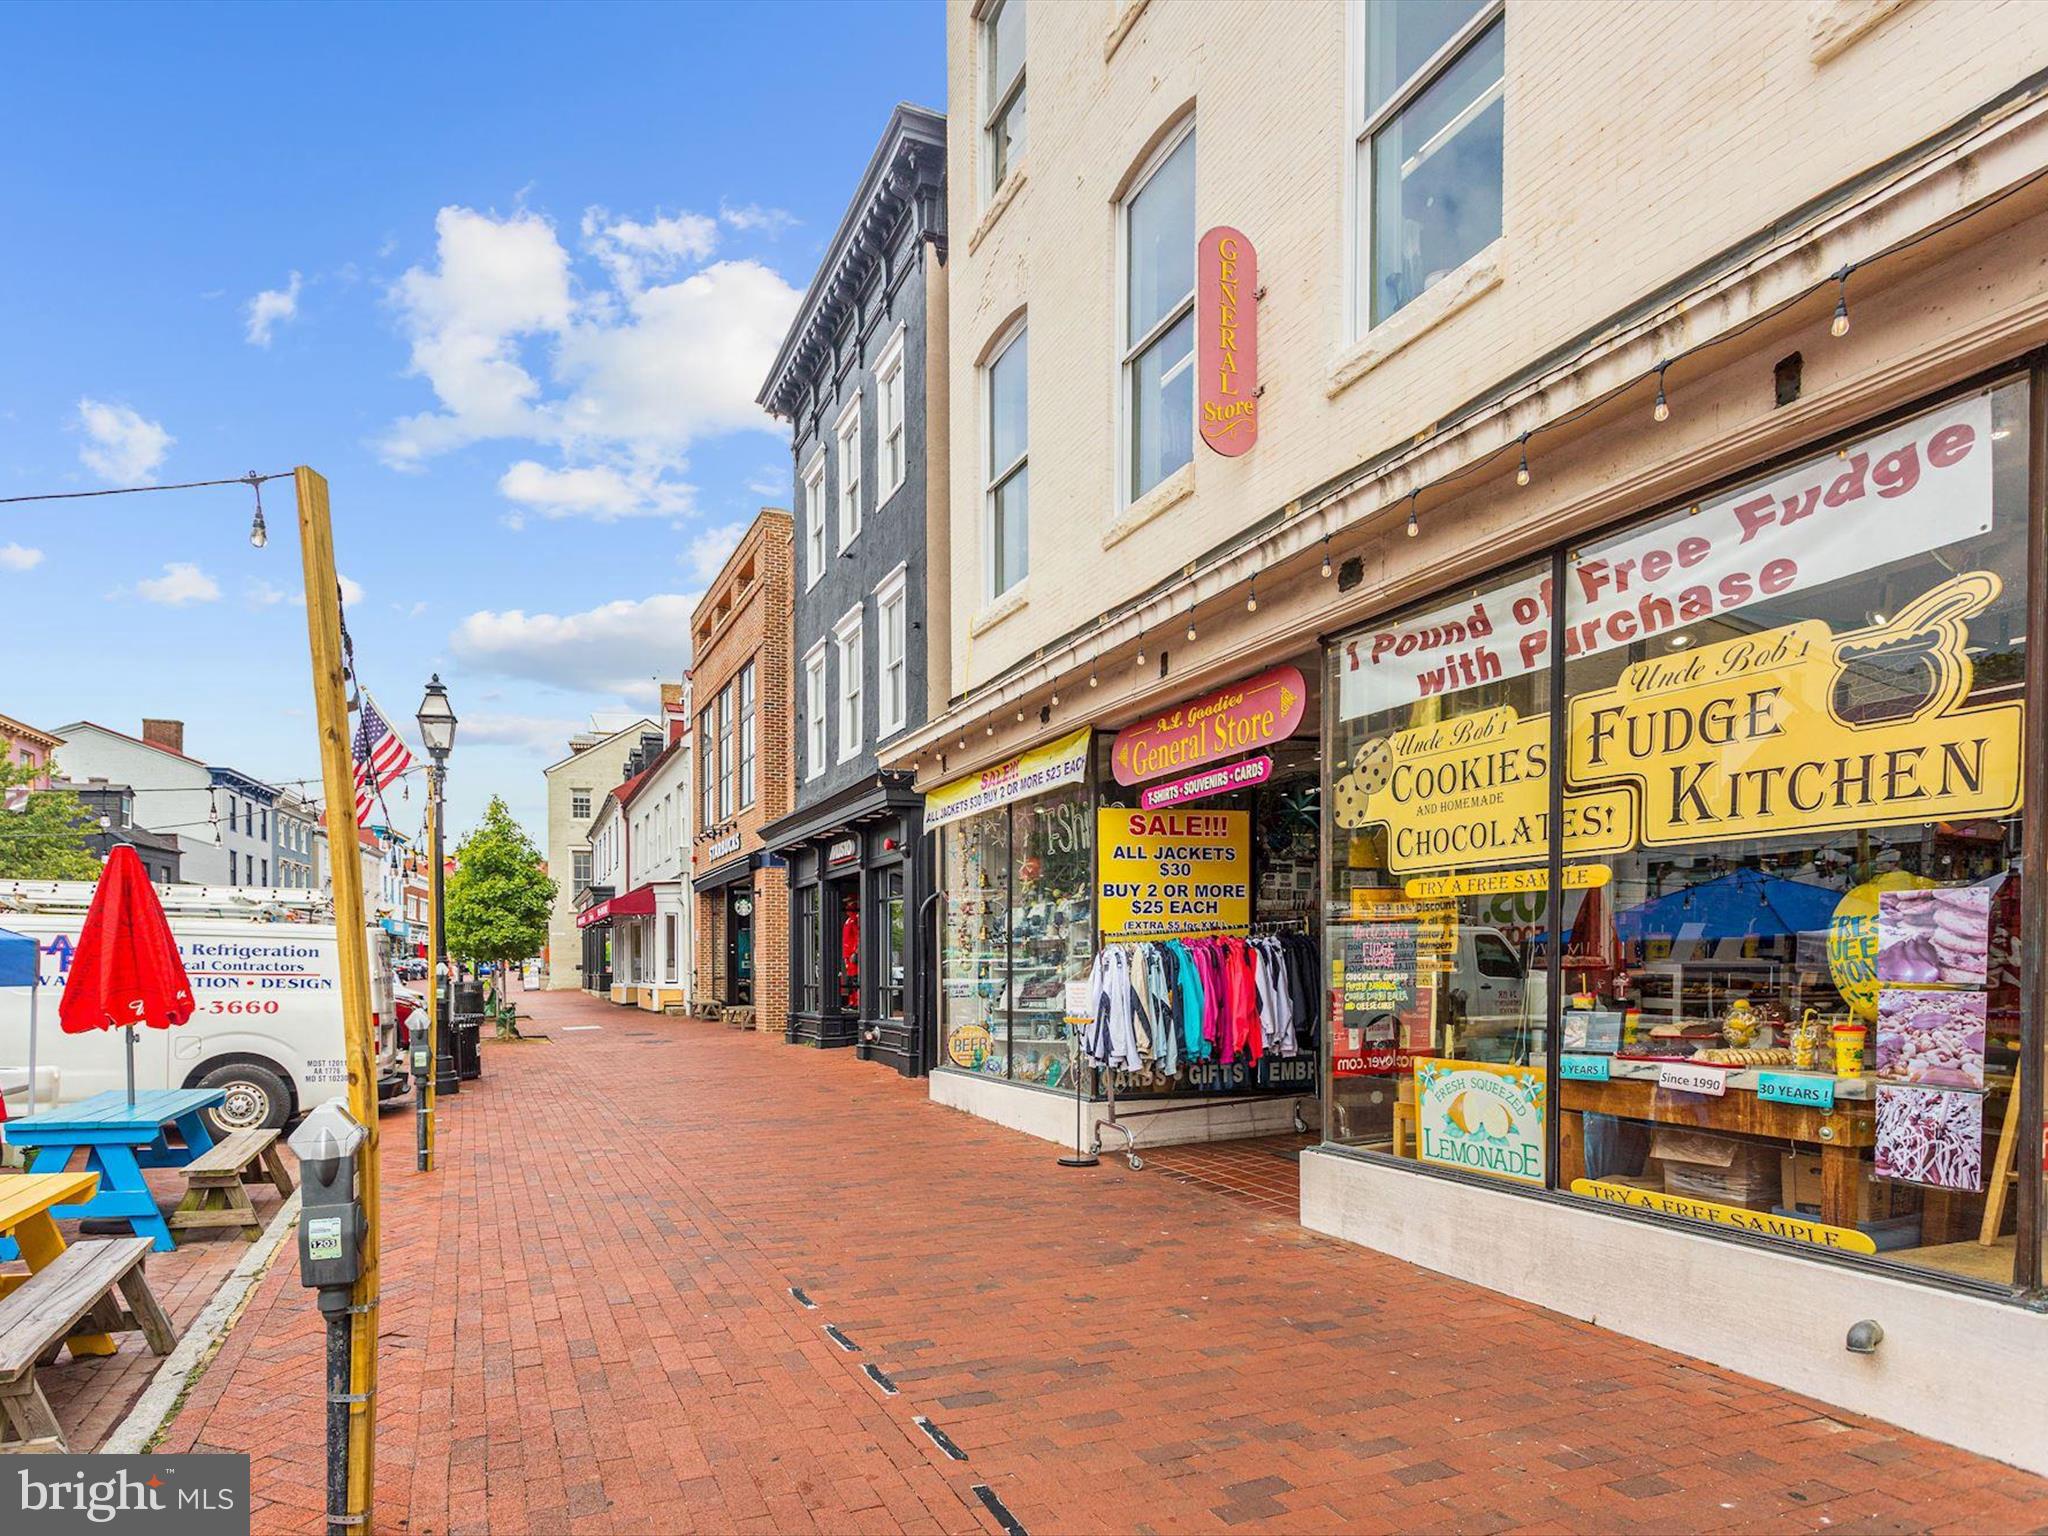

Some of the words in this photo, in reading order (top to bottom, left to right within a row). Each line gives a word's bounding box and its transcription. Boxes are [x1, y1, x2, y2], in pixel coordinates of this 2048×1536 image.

[1218, 238, 1238, 396] GENERAL
[1203, 400, 1253, 422] Store
[1346, 641, 1360, 671] 1
[1372, 603, 1493, 665] Pound
[1577, 537, 1711, 604] Free
[1733, 424, 1975, 545] Fudge
[1416, 646, 1502, 696] with
[1519, 559, 1797, 669] Purchase
[1631, 656, 1706, 693] Uncle
[1717, 631, 1809, 675] Bob's
[1187, 693, 1244, 728] Goodies
[1587, 687, 1787, 768] FUDGE
[1132, 720, 1206, 776] General
[1214, 710, 1275, 754] Store
[1397, 729, 1443, 756] Uncle
[1147, 785, 1179, 805] T-SHIRTS
[1183, 771, 1229, 796] SOUVENIRS
[1234, 761, 1264, 782] CARDS
[1392, 744, 1548, 804] COOKIES
[1668, 738, 1990, 828] KITCHEN
[926, 812, 939, 824] ALL
[940, 800, 968, 819] JACKETS
[983, 789, 998, 805] BUY
[1000, 786, 1005, 798] 2
[1007, 782, 1019, 795] OR
[1020, 772, 1043, 789] MORE
[1046, 765, 1061, 782] $25
[1416, 804, 1438, 817] AND
[1440, 792, 1505, 813] HOMEMADE
[1129, 814, 1228, 837] SALE!!!
[1113, 846, 1147, 860] ALL
[1153, 846, 1236, 861] JACKETS
[1159, 862, 1191, 877] $30
[1103, 884, 1140, 898] BUY
[1147, 884, 1158, 898] 2
[1164, 884, 1188, 898] OR
[1195, 884, 1245, 898] MORE
[1420, 882, 1445, 895] TRY
[1451, 880, 1461, 893] A
[1468, 877, 1506, 892] FREE
[1131, 900, 1163, 914] $25
[1169, 901, 1218, 914] EACH
[1123, 920, 1164, 931] (EXTRA
[1167, 920, 1179, 931] $5
[192, 943, 320, 960] Refrigeration
[211, 960, 305, 972] Contractors
[261, 977, 333, 989] DESIGN
[954, 1037, 988, 1052] BEER
[1190, 1063, 1244, 1084] GIFTS
[1569, 1064, 1600, 1076] YEARS
[1661, 1072, 1690, 1086] Since
[1693, 1077, 1721, 1091] 1990
[1434, 1079, 1465, 1102] FRESH
[1470, 1077, 1527, 1117] SQUEEZED
[1760, 1083, 1775, 1095] 30
[1779, 1086, 1819, 1100] YEARS
[1824, 1090, 1829, 1102] !
[1424, 1127, 1541, 1178] LEMONADE
[1589, 1185, 1632, 1204] TRY
[1641, 1195, 1656, 1209] A
[1661, 1199, 1720, 1222] FREE
[1730, 1212, 1839, 1248] SAMPLE
[311, 1239, 336, 1248] 1203
